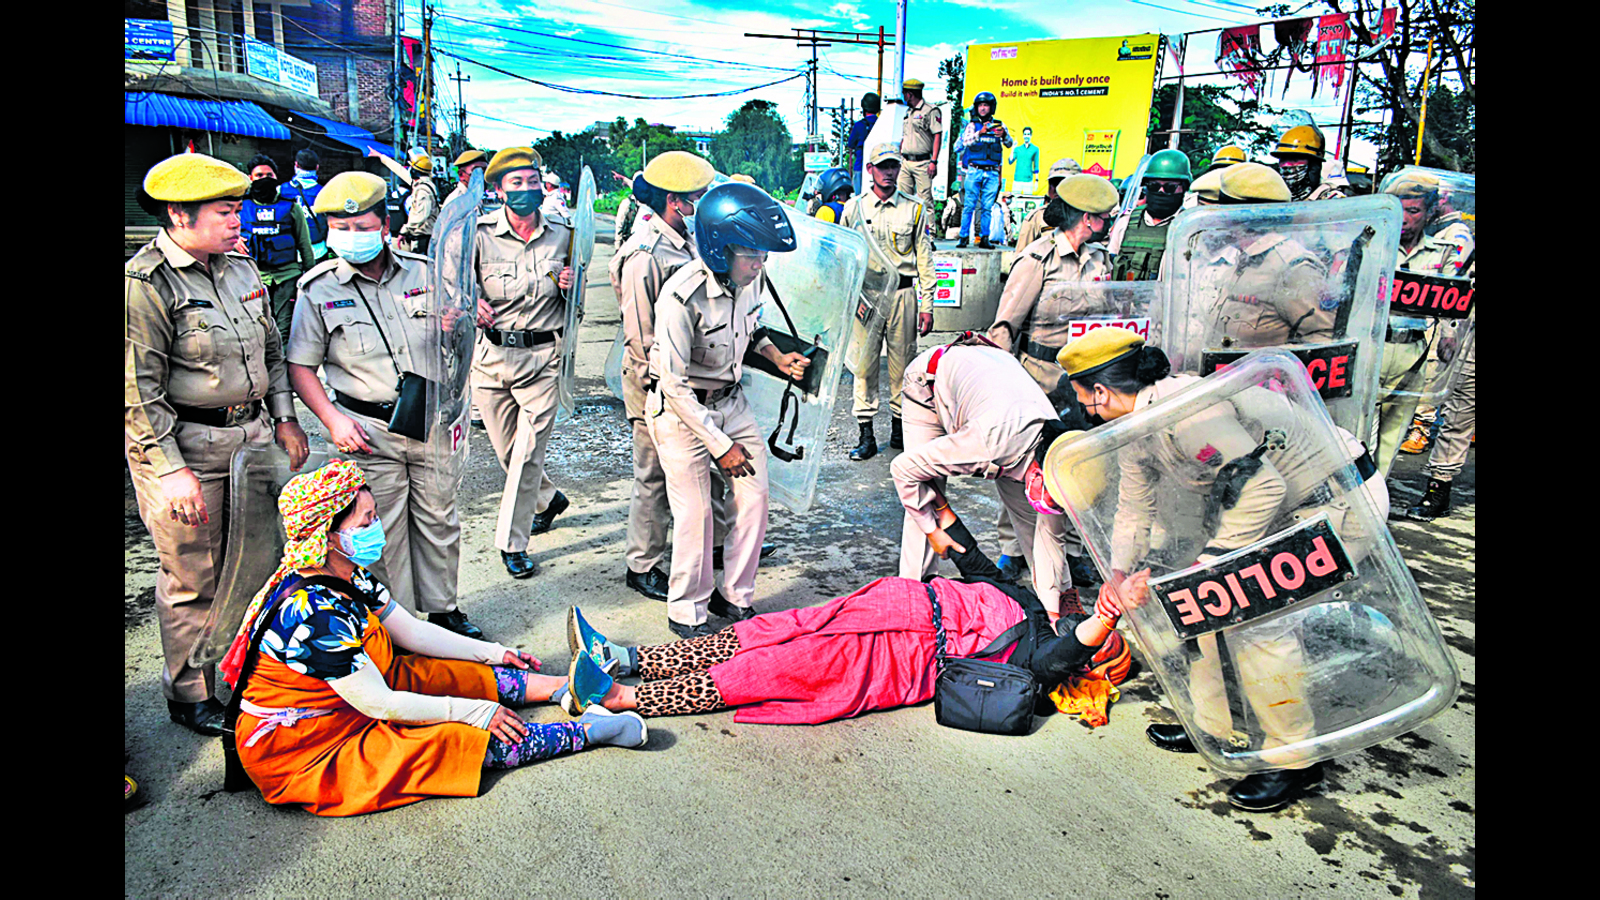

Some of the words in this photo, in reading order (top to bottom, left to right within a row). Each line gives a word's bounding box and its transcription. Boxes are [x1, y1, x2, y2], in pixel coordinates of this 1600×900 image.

[131, 37, 171, 46] CENTRE
[1001, 78, 1028, 87] Home
[1030, 76, 1038, 86] is
[1040, 75, 1062, 86] built
[1063, 74, 1084, 87] only
[1086, 75, 1110, 84] once
[1080, 88, 1106, 96] CEMENT
[1167, 535, 1339, 626] POLICE
